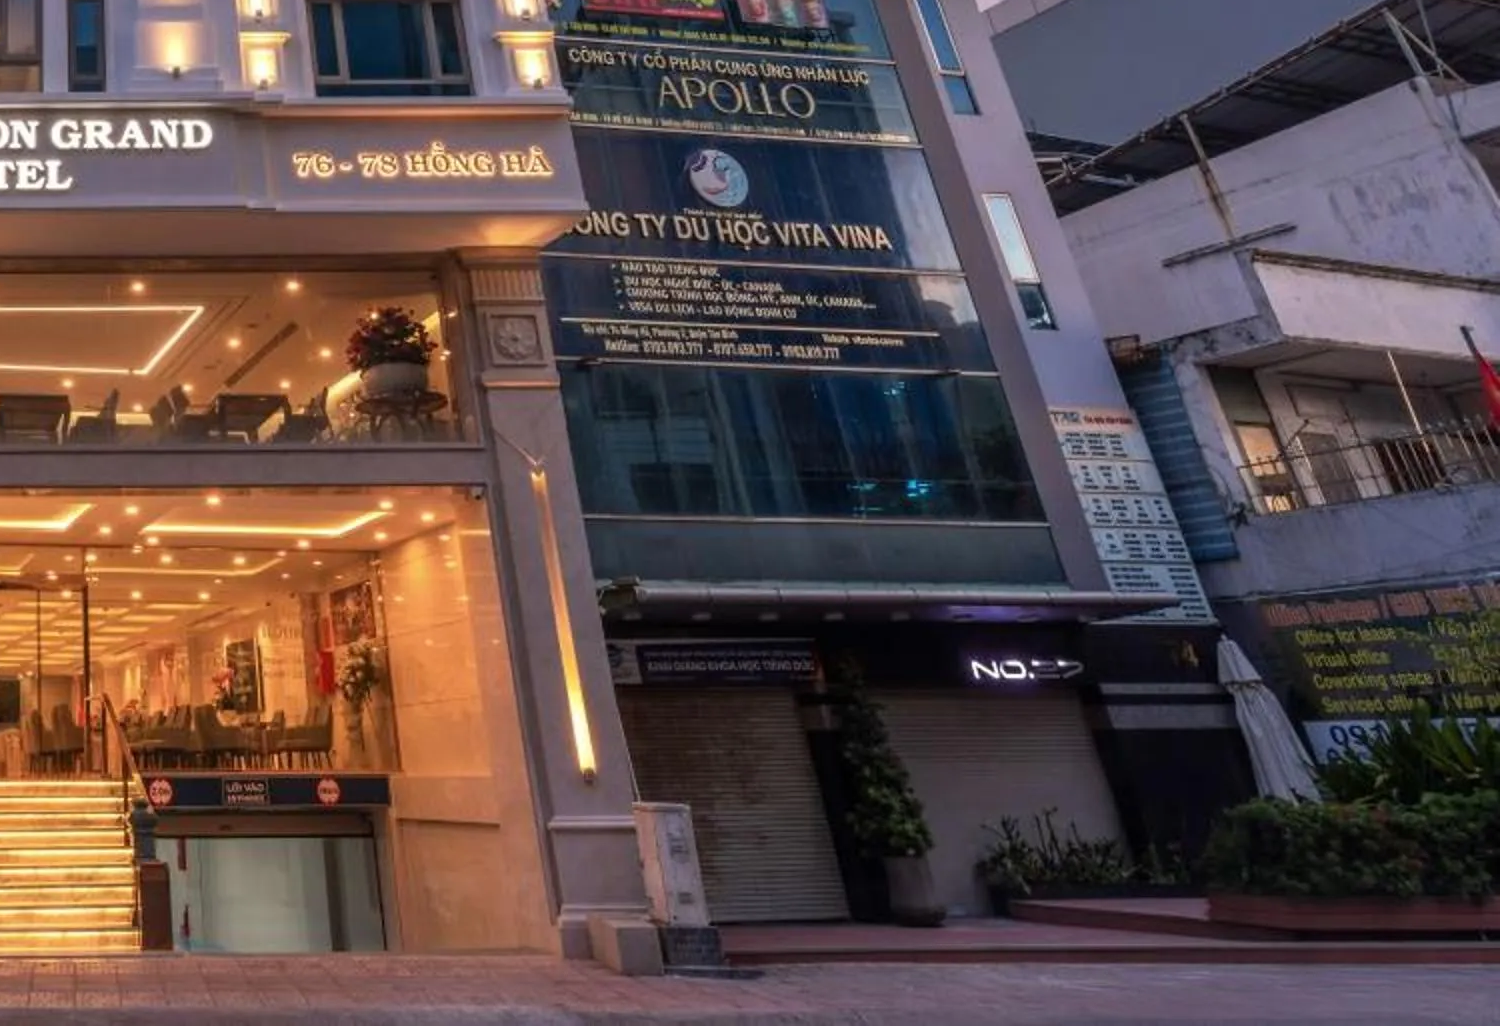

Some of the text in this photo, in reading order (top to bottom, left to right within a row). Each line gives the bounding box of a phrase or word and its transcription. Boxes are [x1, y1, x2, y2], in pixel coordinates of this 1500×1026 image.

[568, 46, 615, 65] CÔNG
[620, 51, 638, 66] TY
[715, 59, 757, 78] CUNG
[658, 75, 816, 119] APOLLO
[50, 119, 214, 150] GRAND
[293, 152, 334, 177] 76
[358, 152, 398, 177] 78
[405, 141, 496, 176] HỒNG
[500, 145, 553, 176] HÀ
[633, 213, 667, 239] TY
[674, 216, 709, 241] DU
[716, 218, 770, 251] HỌC
[772, 221, 829, 248] VITA
[830, 224, 893, 250] VINA
[971, 659, 1083, 679] NO.27
[1312, 673, 1389, 692] Coworking
